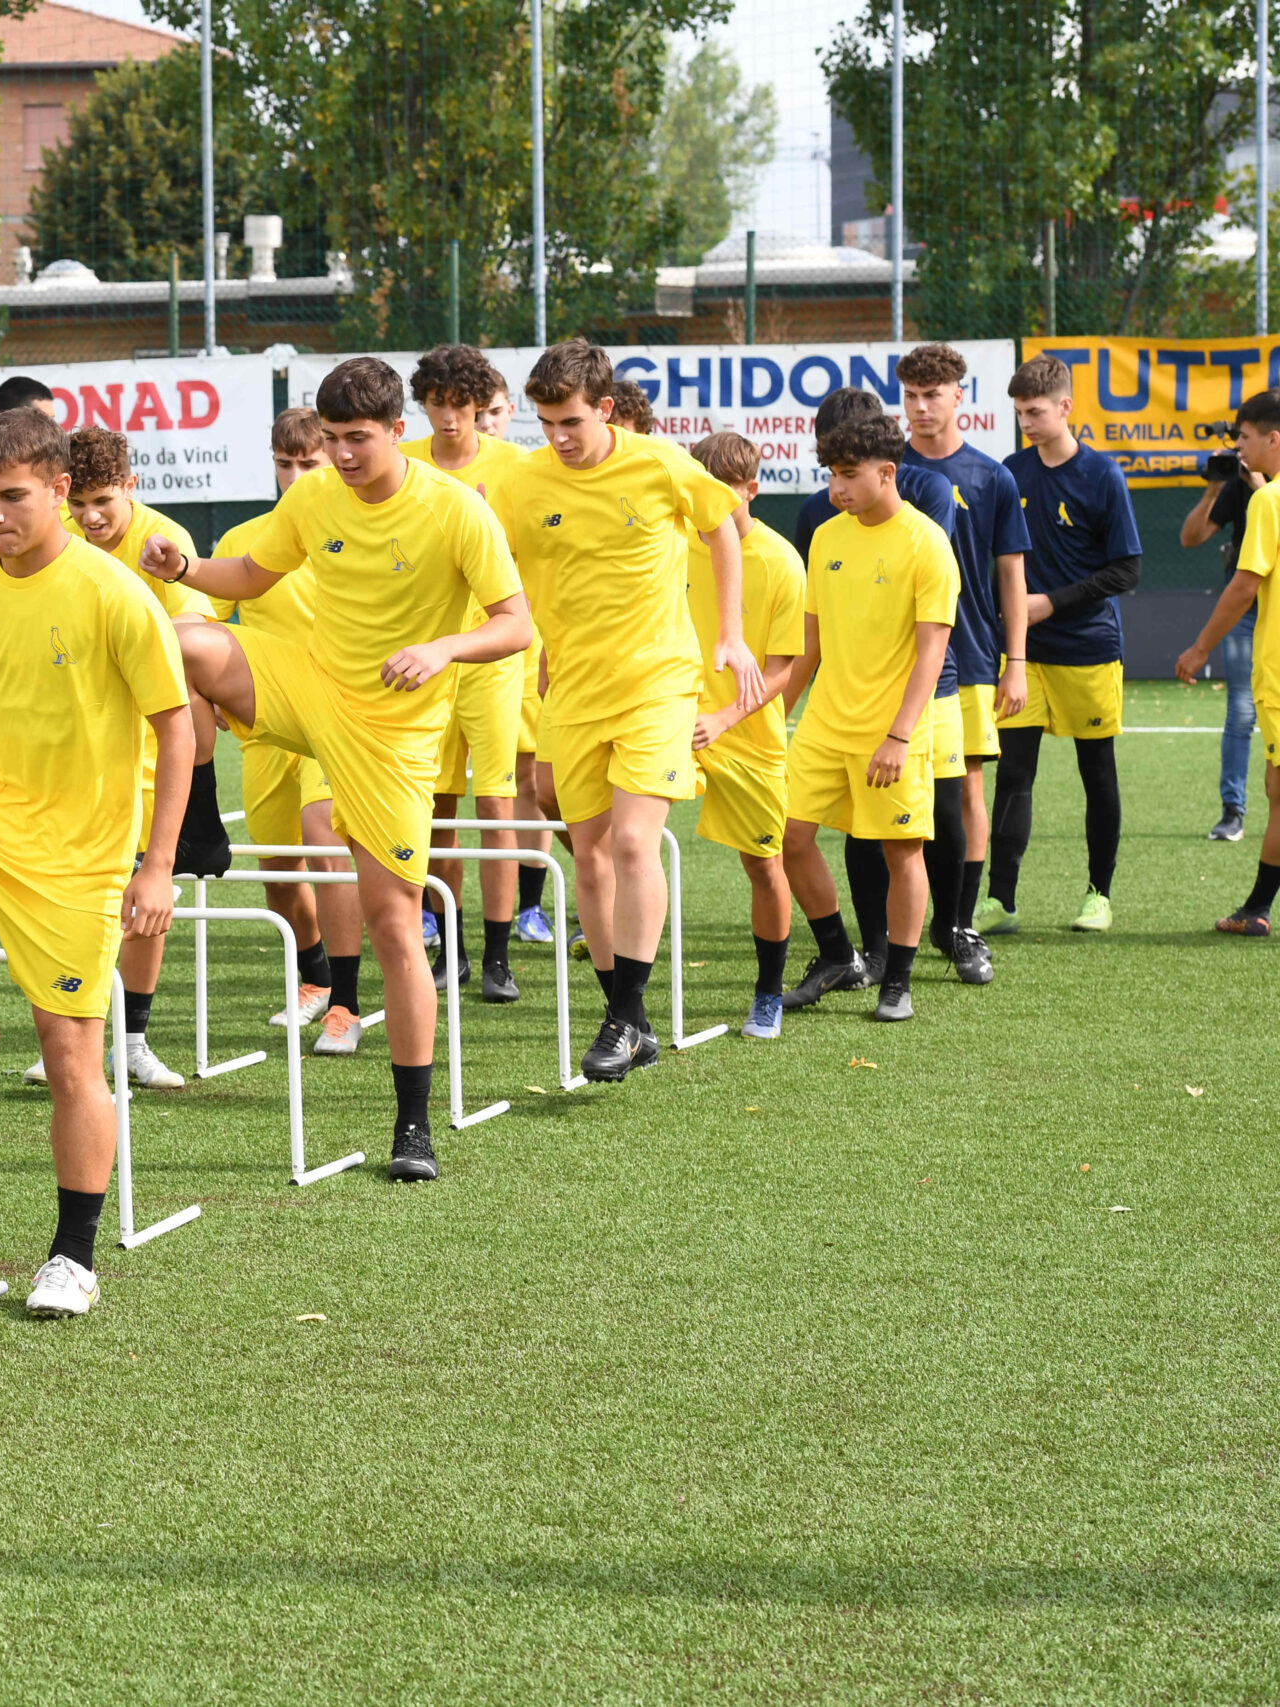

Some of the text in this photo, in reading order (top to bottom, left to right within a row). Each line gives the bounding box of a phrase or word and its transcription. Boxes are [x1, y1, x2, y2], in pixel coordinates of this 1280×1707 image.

[50, 380, 221, 433] ONAD
[652, 417, 713, 435] NERIA
[1070, 424, 1094, 441] IA
[1105, 424, 1184, 441] EMILIA
[156, 446, 176, 465] da
[184, 443, 228, 464] Vinci
[1108, 455, 1198, 473] CARPE
[162, 472, 211, 490] Ovest
